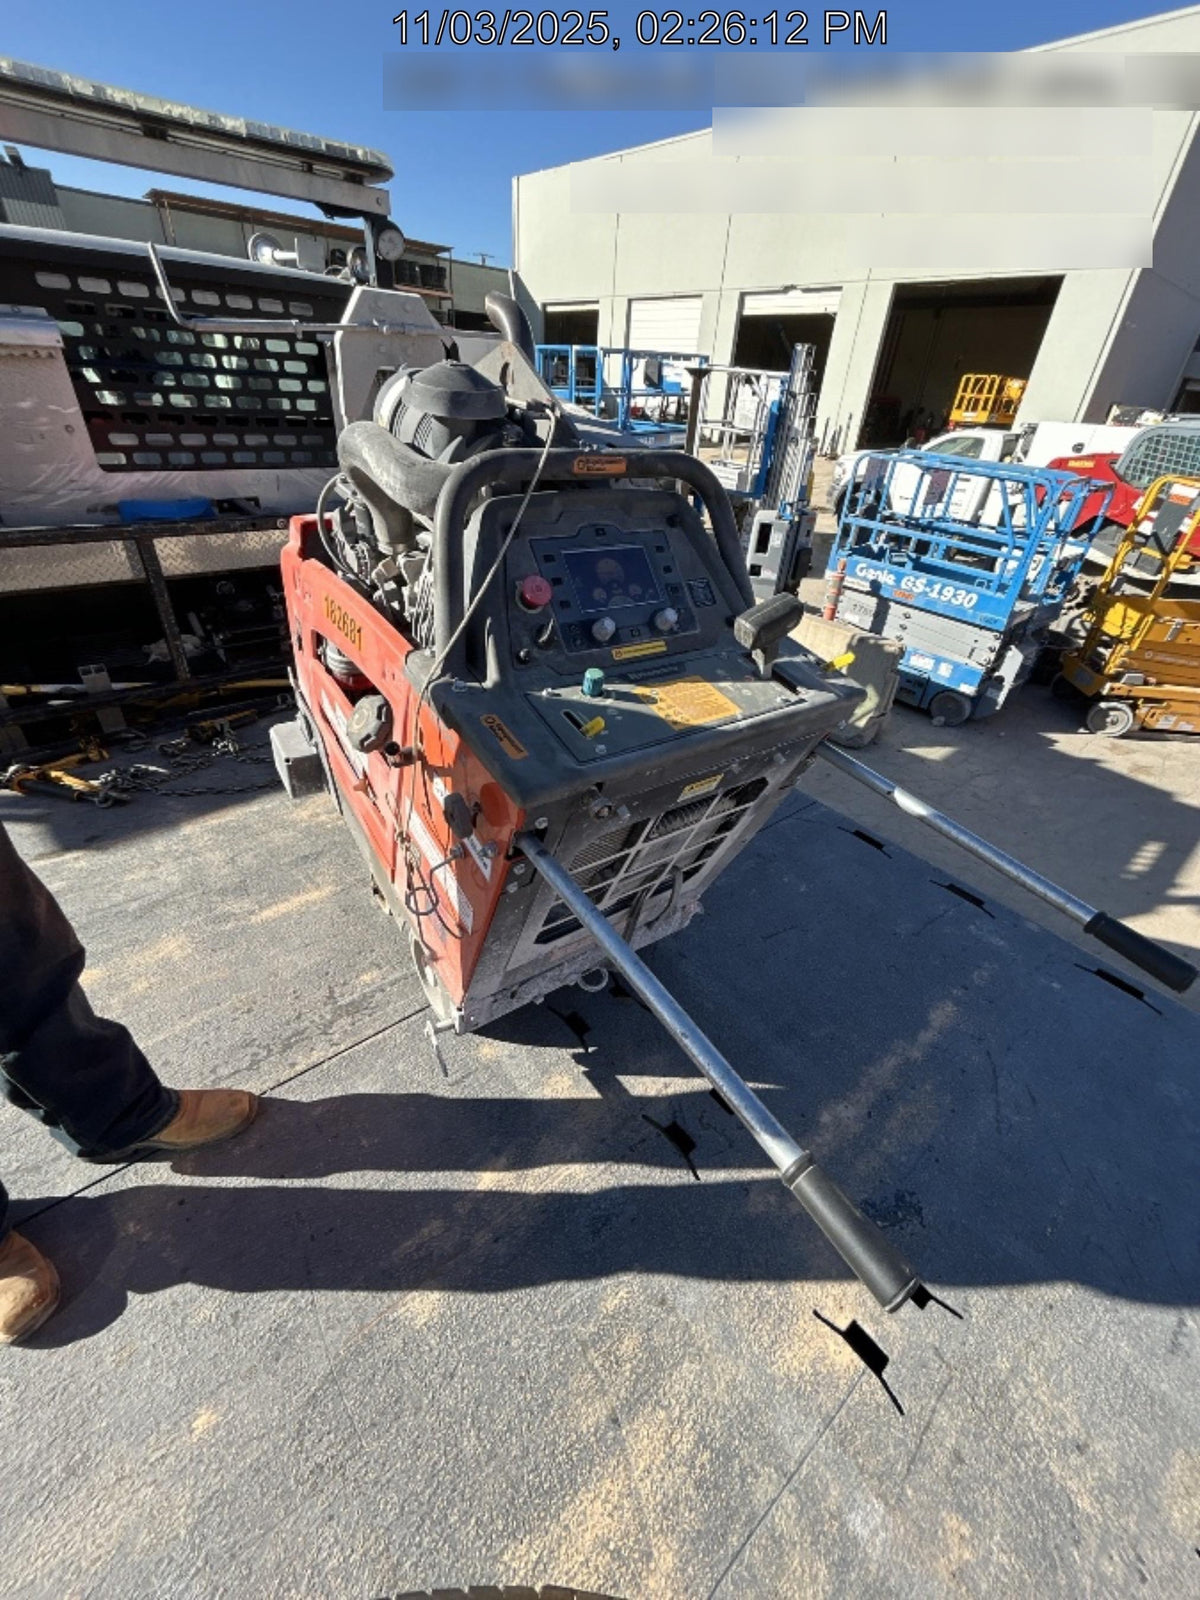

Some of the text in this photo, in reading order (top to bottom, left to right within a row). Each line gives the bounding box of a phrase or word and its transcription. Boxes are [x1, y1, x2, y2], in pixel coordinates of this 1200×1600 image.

[855, 563, 896, 586] Genie
[901, 575, 978, 609] GS-1930
[324, 594, 362, 651] 182681
